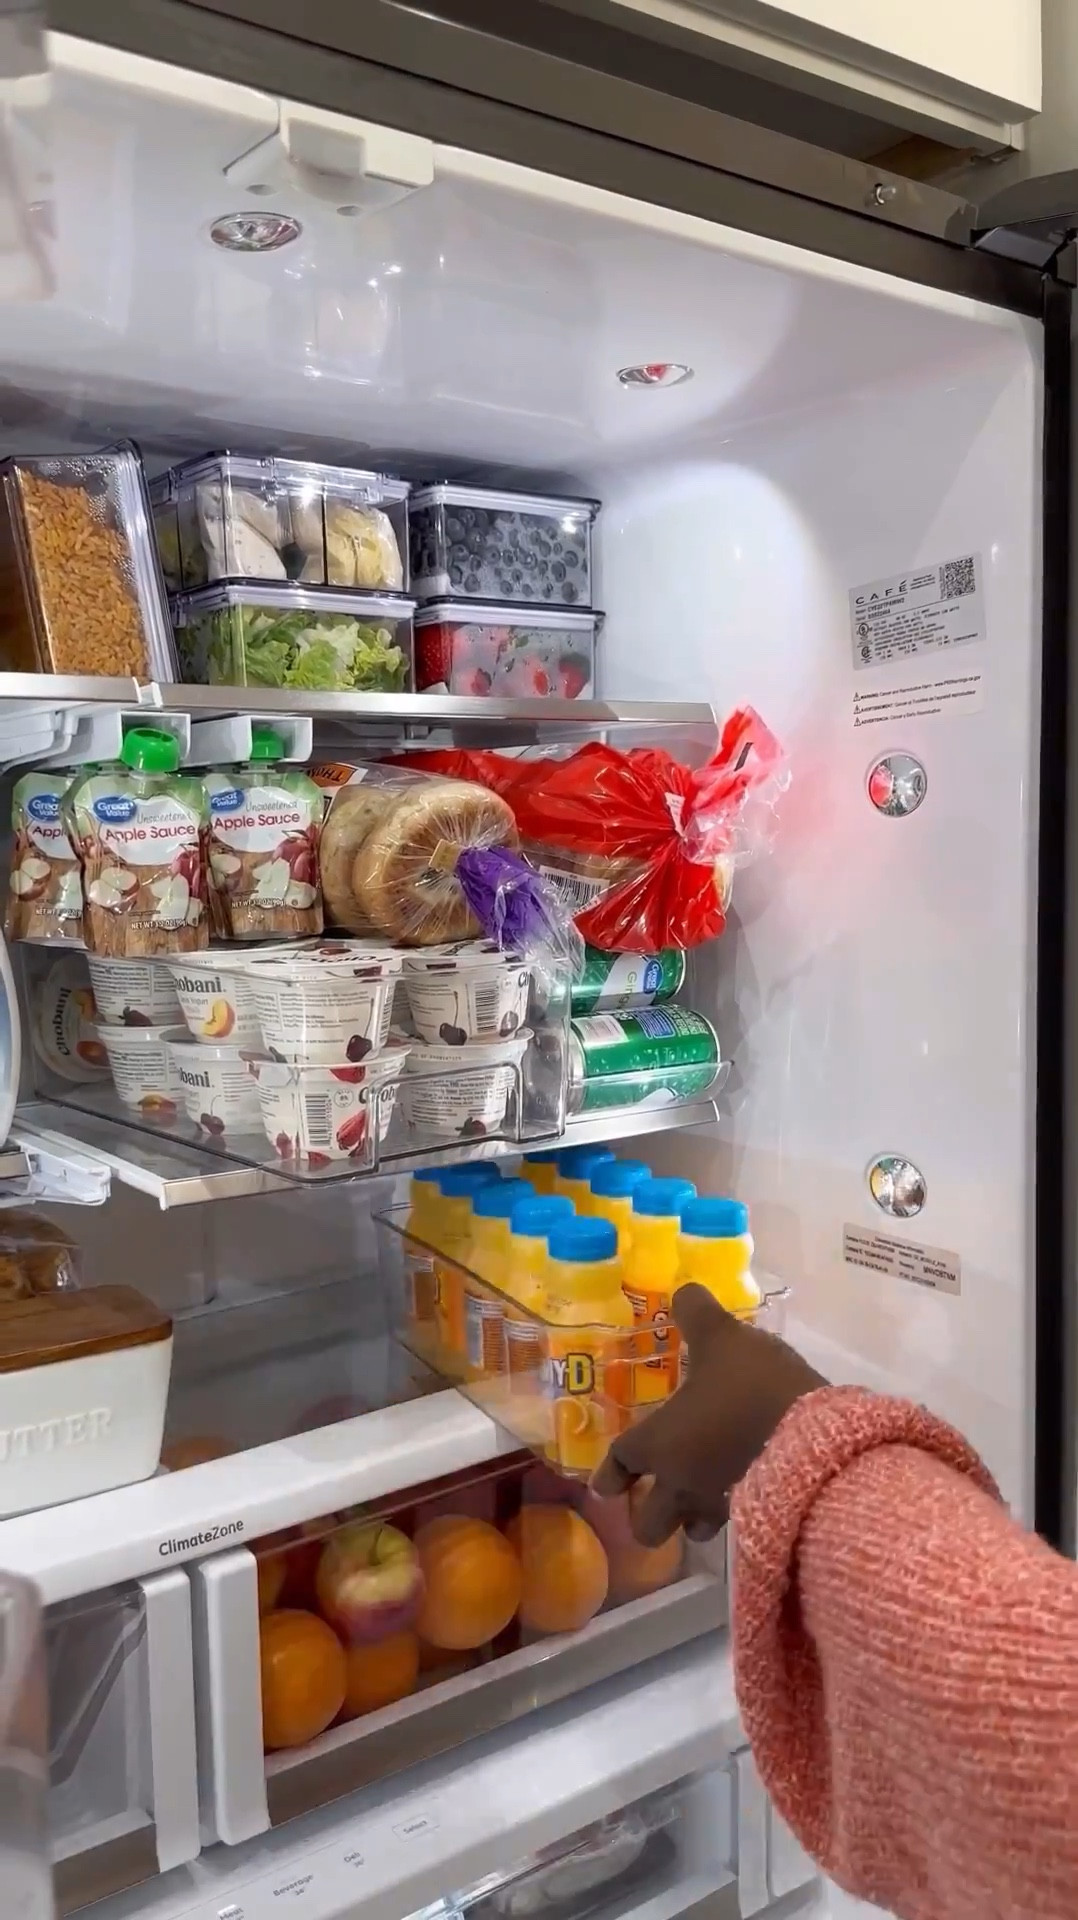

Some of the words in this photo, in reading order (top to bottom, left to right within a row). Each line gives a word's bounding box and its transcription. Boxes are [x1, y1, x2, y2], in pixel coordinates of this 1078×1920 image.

[855, 579, 907, 605] CAFÉ
[32, 800, 59, 810] Grea
[40, 809, 59, 817] Valu
[97, 802, 131, 811] Great
[106, 809, 131, 818] Value
[213, 816, 255, 831] Apple
[258, 812, 300, 827] Sauce
[32, 826, 65, 840] Appl
[105, 827, 146, 842] Apple
[150, 824, 195, 839] Sauce
[159, 1520, 244, 1556] ClimateZone
[273, 1874, 313, 1897] Beverage
